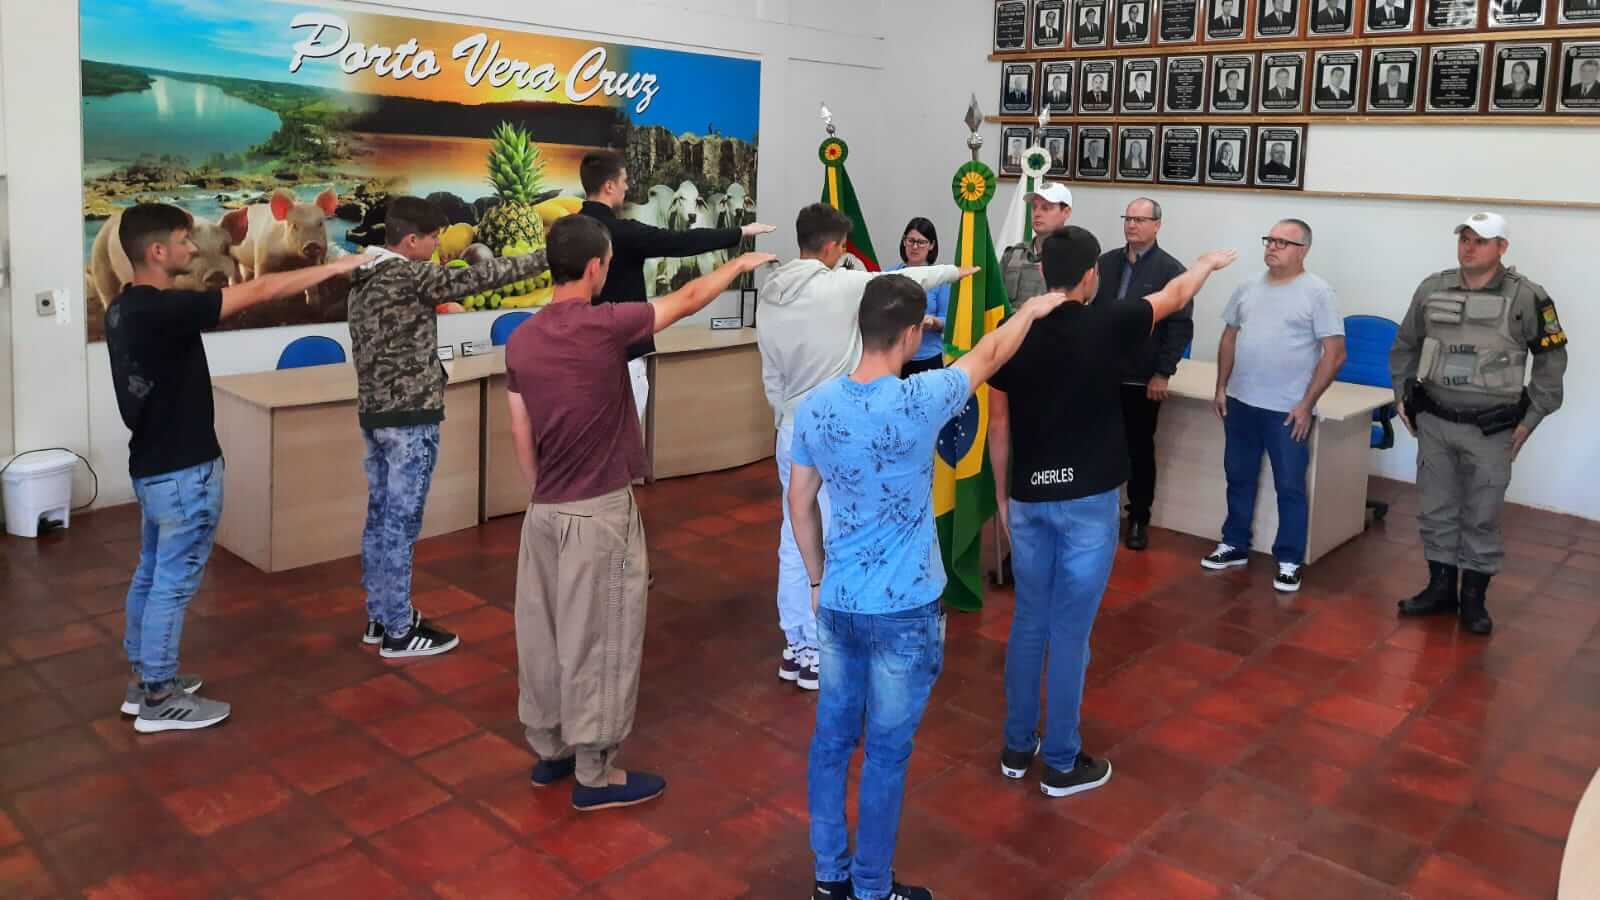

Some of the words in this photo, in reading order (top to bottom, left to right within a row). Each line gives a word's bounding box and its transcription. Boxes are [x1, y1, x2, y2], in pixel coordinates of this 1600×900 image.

[289, 12, 441, 80] Porto
[452, 33, 561, 92] Vera
[565, 46, 661, 113] Cruz
[1030, 467, 1074, 485] CHERLES
